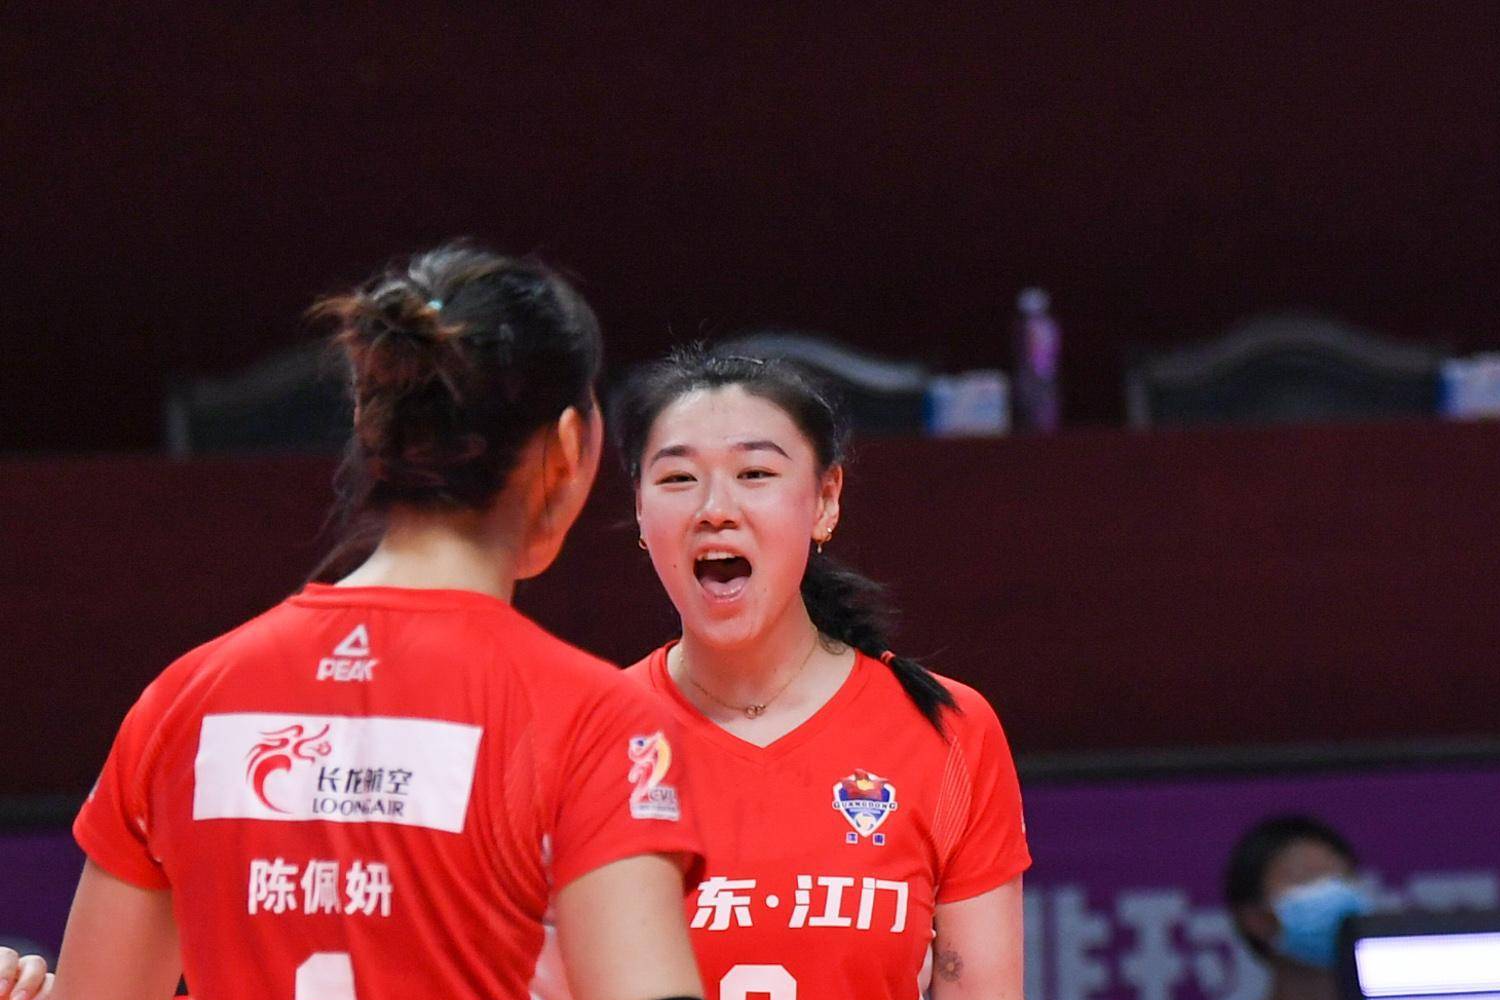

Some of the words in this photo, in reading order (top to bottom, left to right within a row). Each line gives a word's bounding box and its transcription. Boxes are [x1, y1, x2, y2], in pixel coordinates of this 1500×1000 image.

[316, 657, 379, 682] PEAK
[317, 766, 413, 796] 长龙航空
[833, 800, 897, 810] GUANGDONG
[247, 858, 392, 917] 陈佩妍
[690, 874, 909, 932] 东·江门
